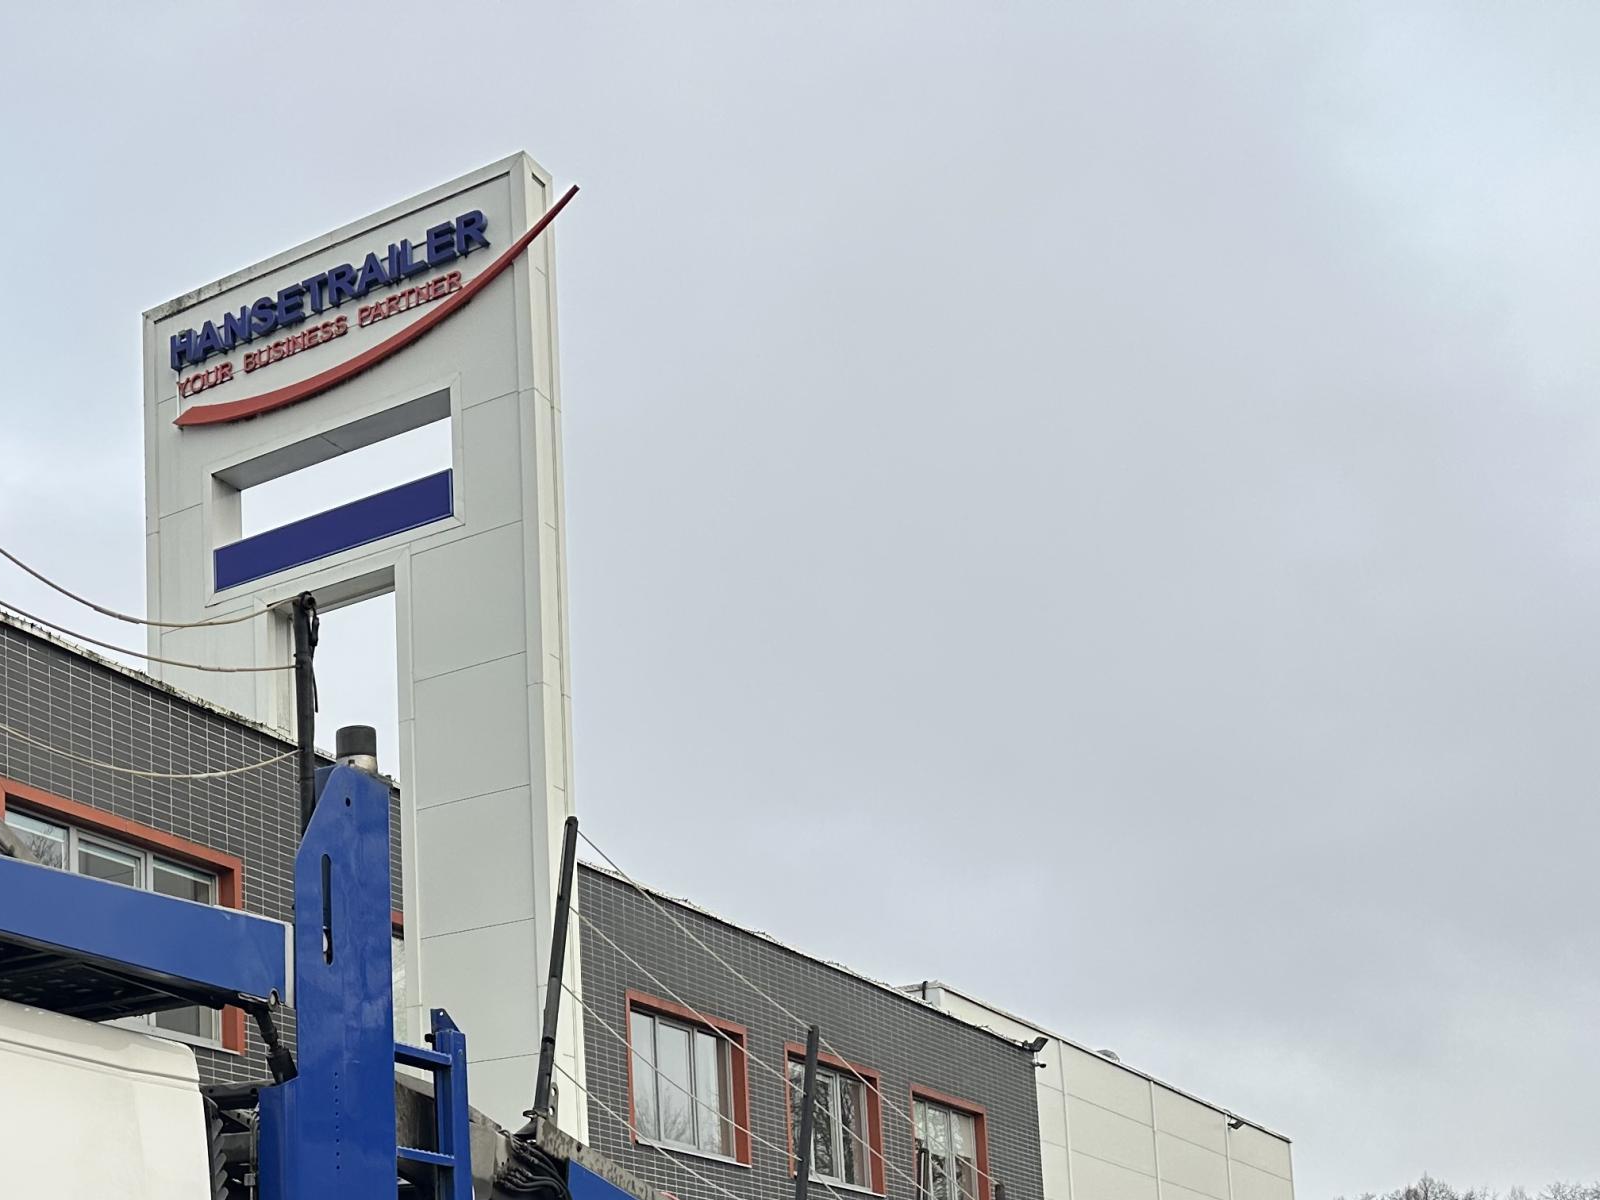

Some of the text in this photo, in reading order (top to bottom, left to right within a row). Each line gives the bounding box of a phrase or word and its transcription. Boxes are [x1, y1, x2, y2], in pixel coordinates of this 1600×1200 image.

[169, 209, 491, 371] HANSETRAILER
[177, 269, 463, 397] YOUR BUSINESS PARTNER
